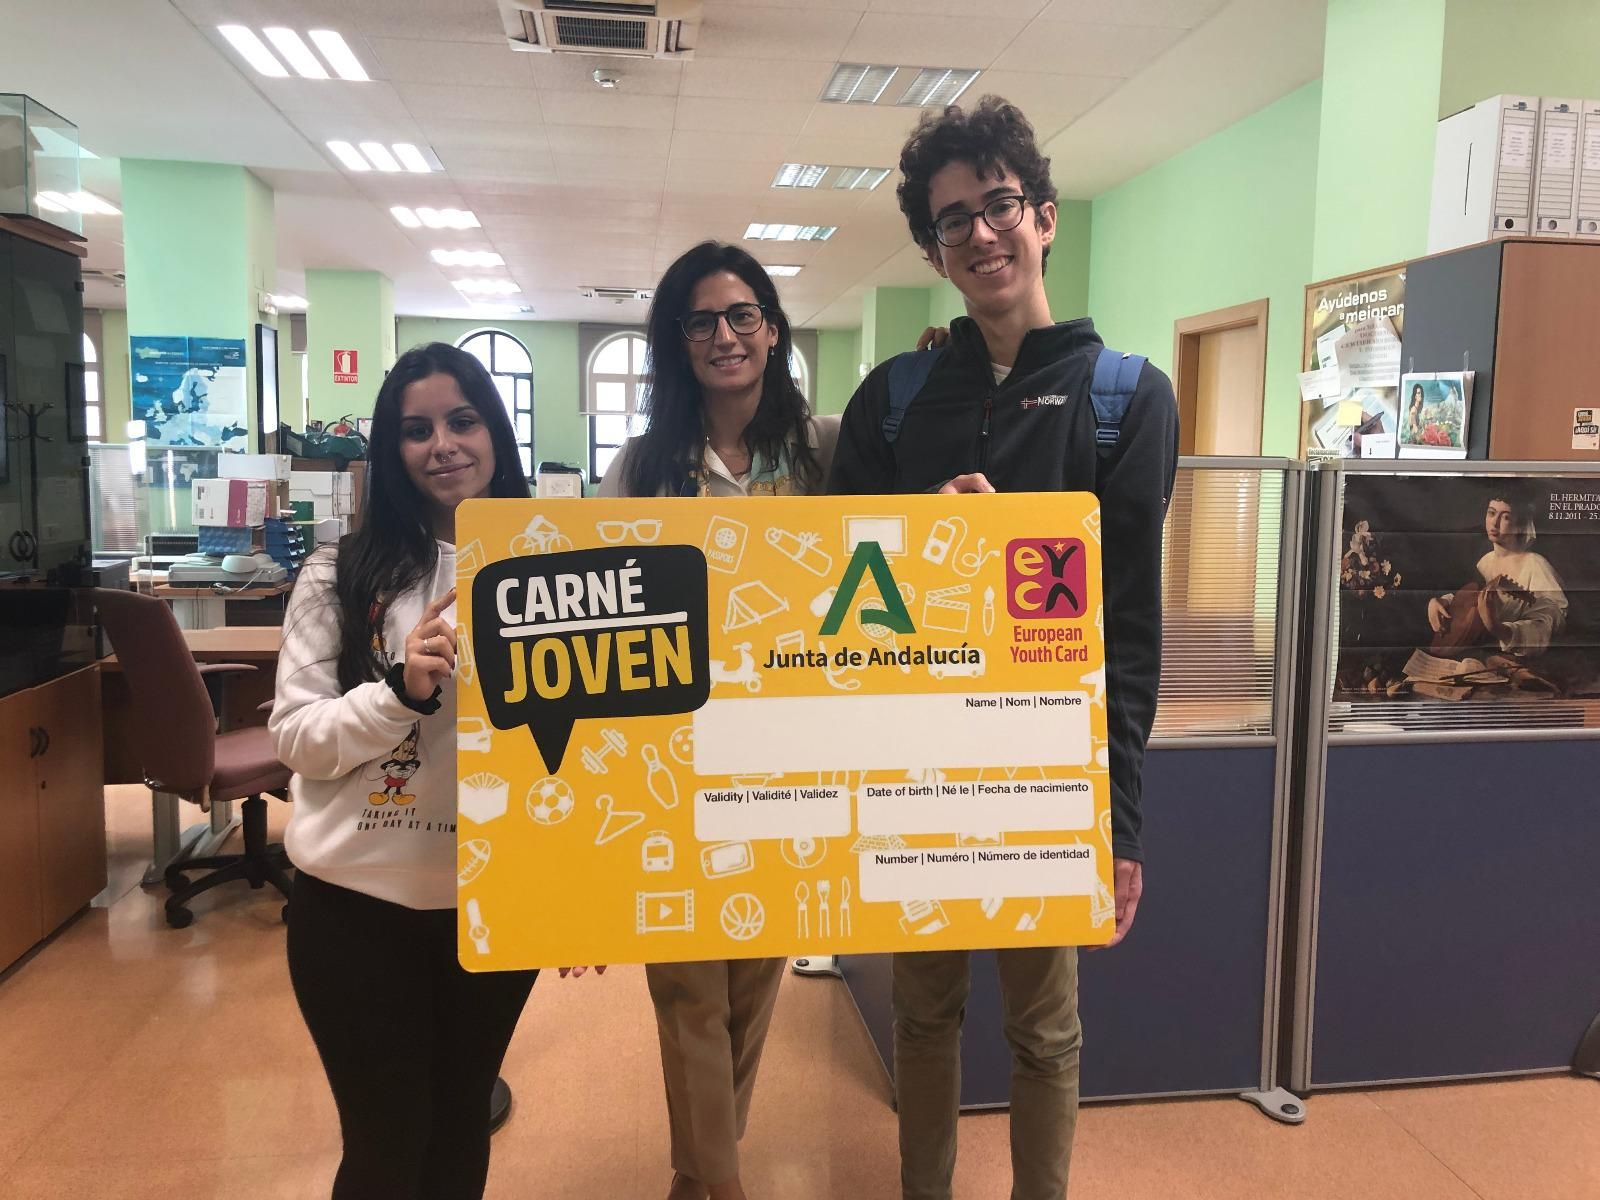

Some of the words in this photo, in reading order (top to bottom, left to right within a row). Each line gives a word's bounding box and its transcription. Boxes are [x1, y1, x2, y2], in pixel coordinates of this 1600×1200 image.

[1317, 289, 1388, 313] Ayúdenos
[334, 375, 358, 383] EXTINTOR
[1551, 493, 1560, 501] EL
[1550, 502, 1561, 511] EN
[1563, 502, 1572, 511] EL
[496, 559, 645, 625] CARNÉ
[1013, 625, 1083, 644] European
[763, 647, 828, 669] Junta
[834, 646, 862, 667] de
[867, 641, 981, 667] Andalucía
[1009, 645, 1053, 663] Youth
[1054, 644, 1088, 663] Card
[503, 625, 693, 704] JOVEN
[965, 697, 997, 708] Name
[1005, 697, 1031, 707] Nom
[1039, 695, 1082, 706] Nombre
[703, 791, 744, 804] Validity
[751, 789, 792, 801] Validité
[799, 788, 839, 799] Validez
[866, 787, 893, 798] Date
[895, 786, 906, 797] of
[908, 785, 933, 796] birth
[941, 784, 957, 795] Né
[959, 784, 970, 795] le
[977, 784, 1011, 795] Fecha
[1013, 783, 1028, 794] de
[1030, 782, 1089, 793] nacimiento
[362, 808, 399, 819] TAKING
[405, 807, 416, 817] IT
[383, 819, 402, 829] DAY
[408, 821, 420, 830] AT
[426, 822, 432, 831] A
[875, 853, 919, 865] Number
[926, 852, 970, 863] Numéro
[978, 851, 1021, 862] Número
[1023, 850, 1037, 860] de
[1039, 848, 1090, 860] identidad
